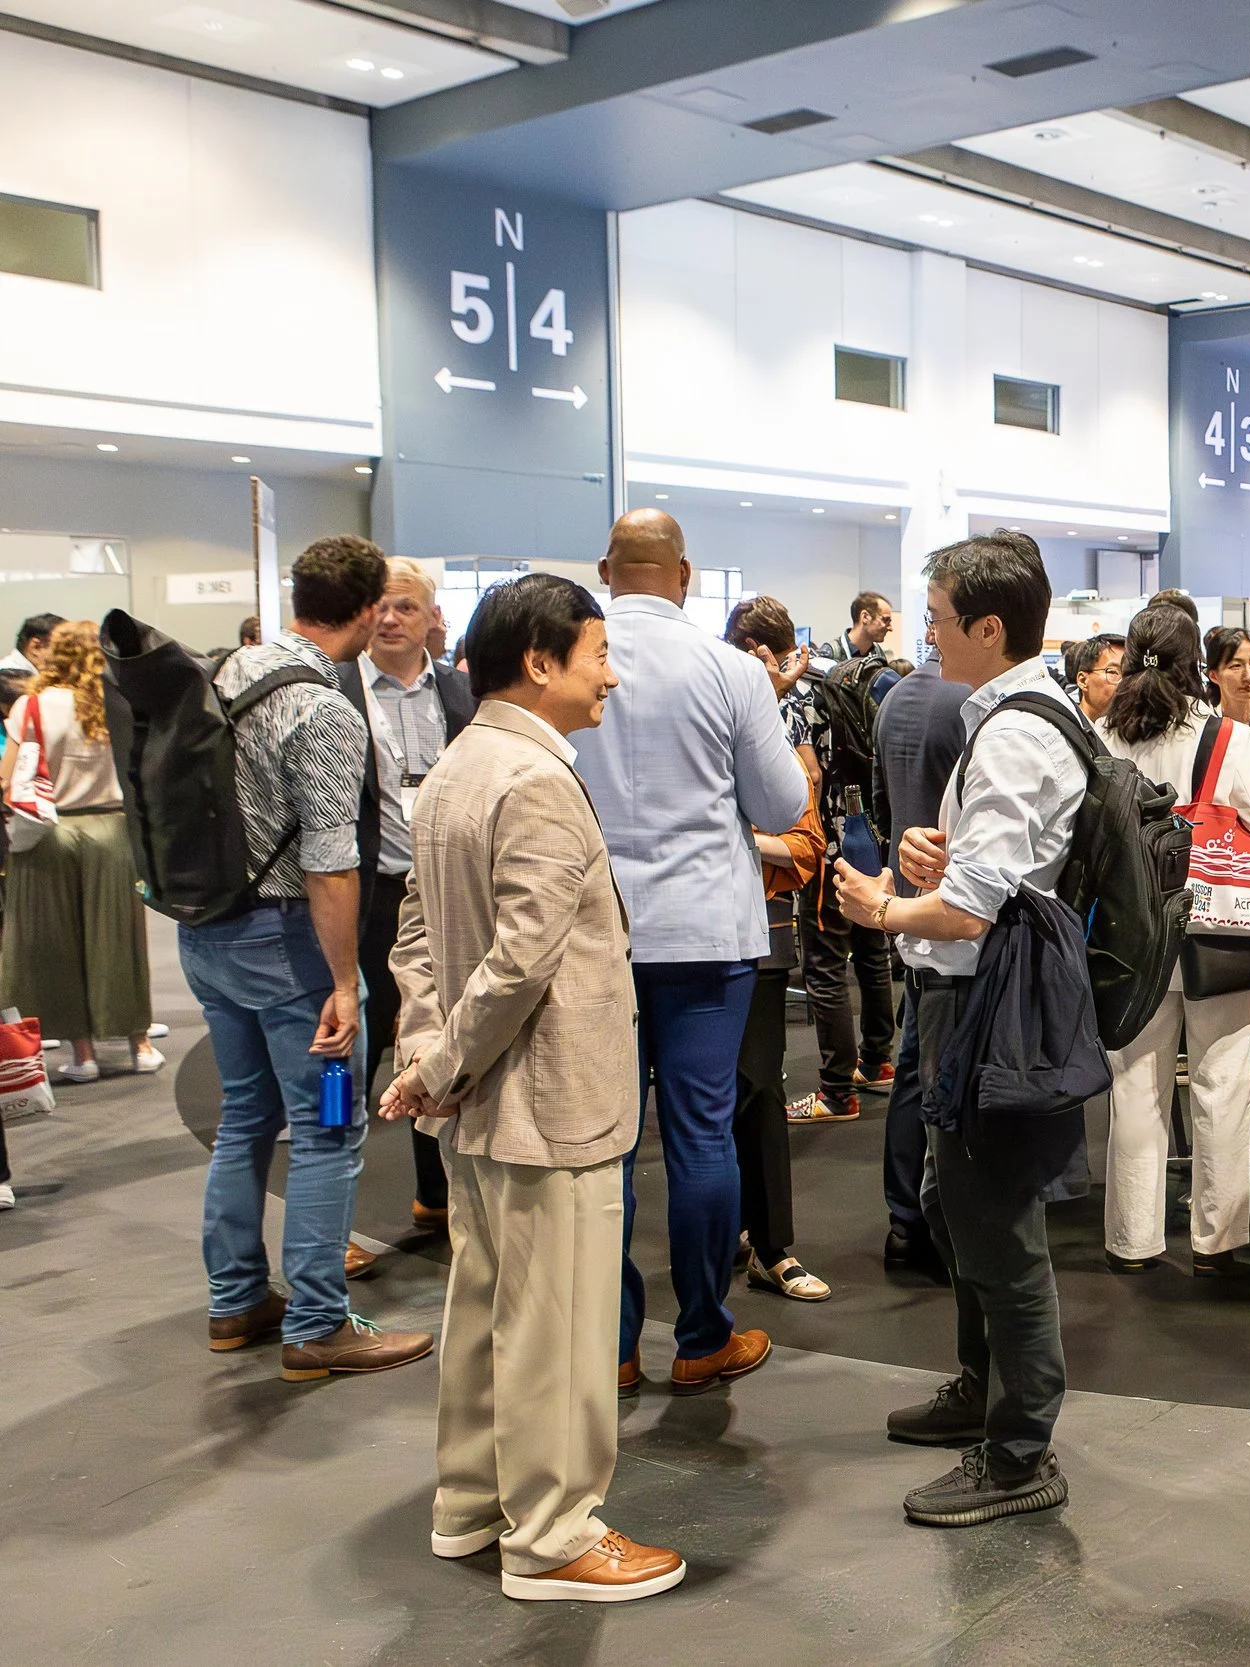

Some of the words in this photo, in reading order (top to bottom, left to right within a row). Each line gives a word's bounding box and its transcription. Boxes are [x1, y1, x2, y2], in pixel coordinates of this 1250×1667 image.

[495, 207, 524, 251] N
[451, 270, 494, 345] 5
[530, 288, 574, 356] 4
[1226, 367, 1240, 394] N
[1205, 411, 1226, 456] 4
[1195, 884, 1212, 896] ISSCR
